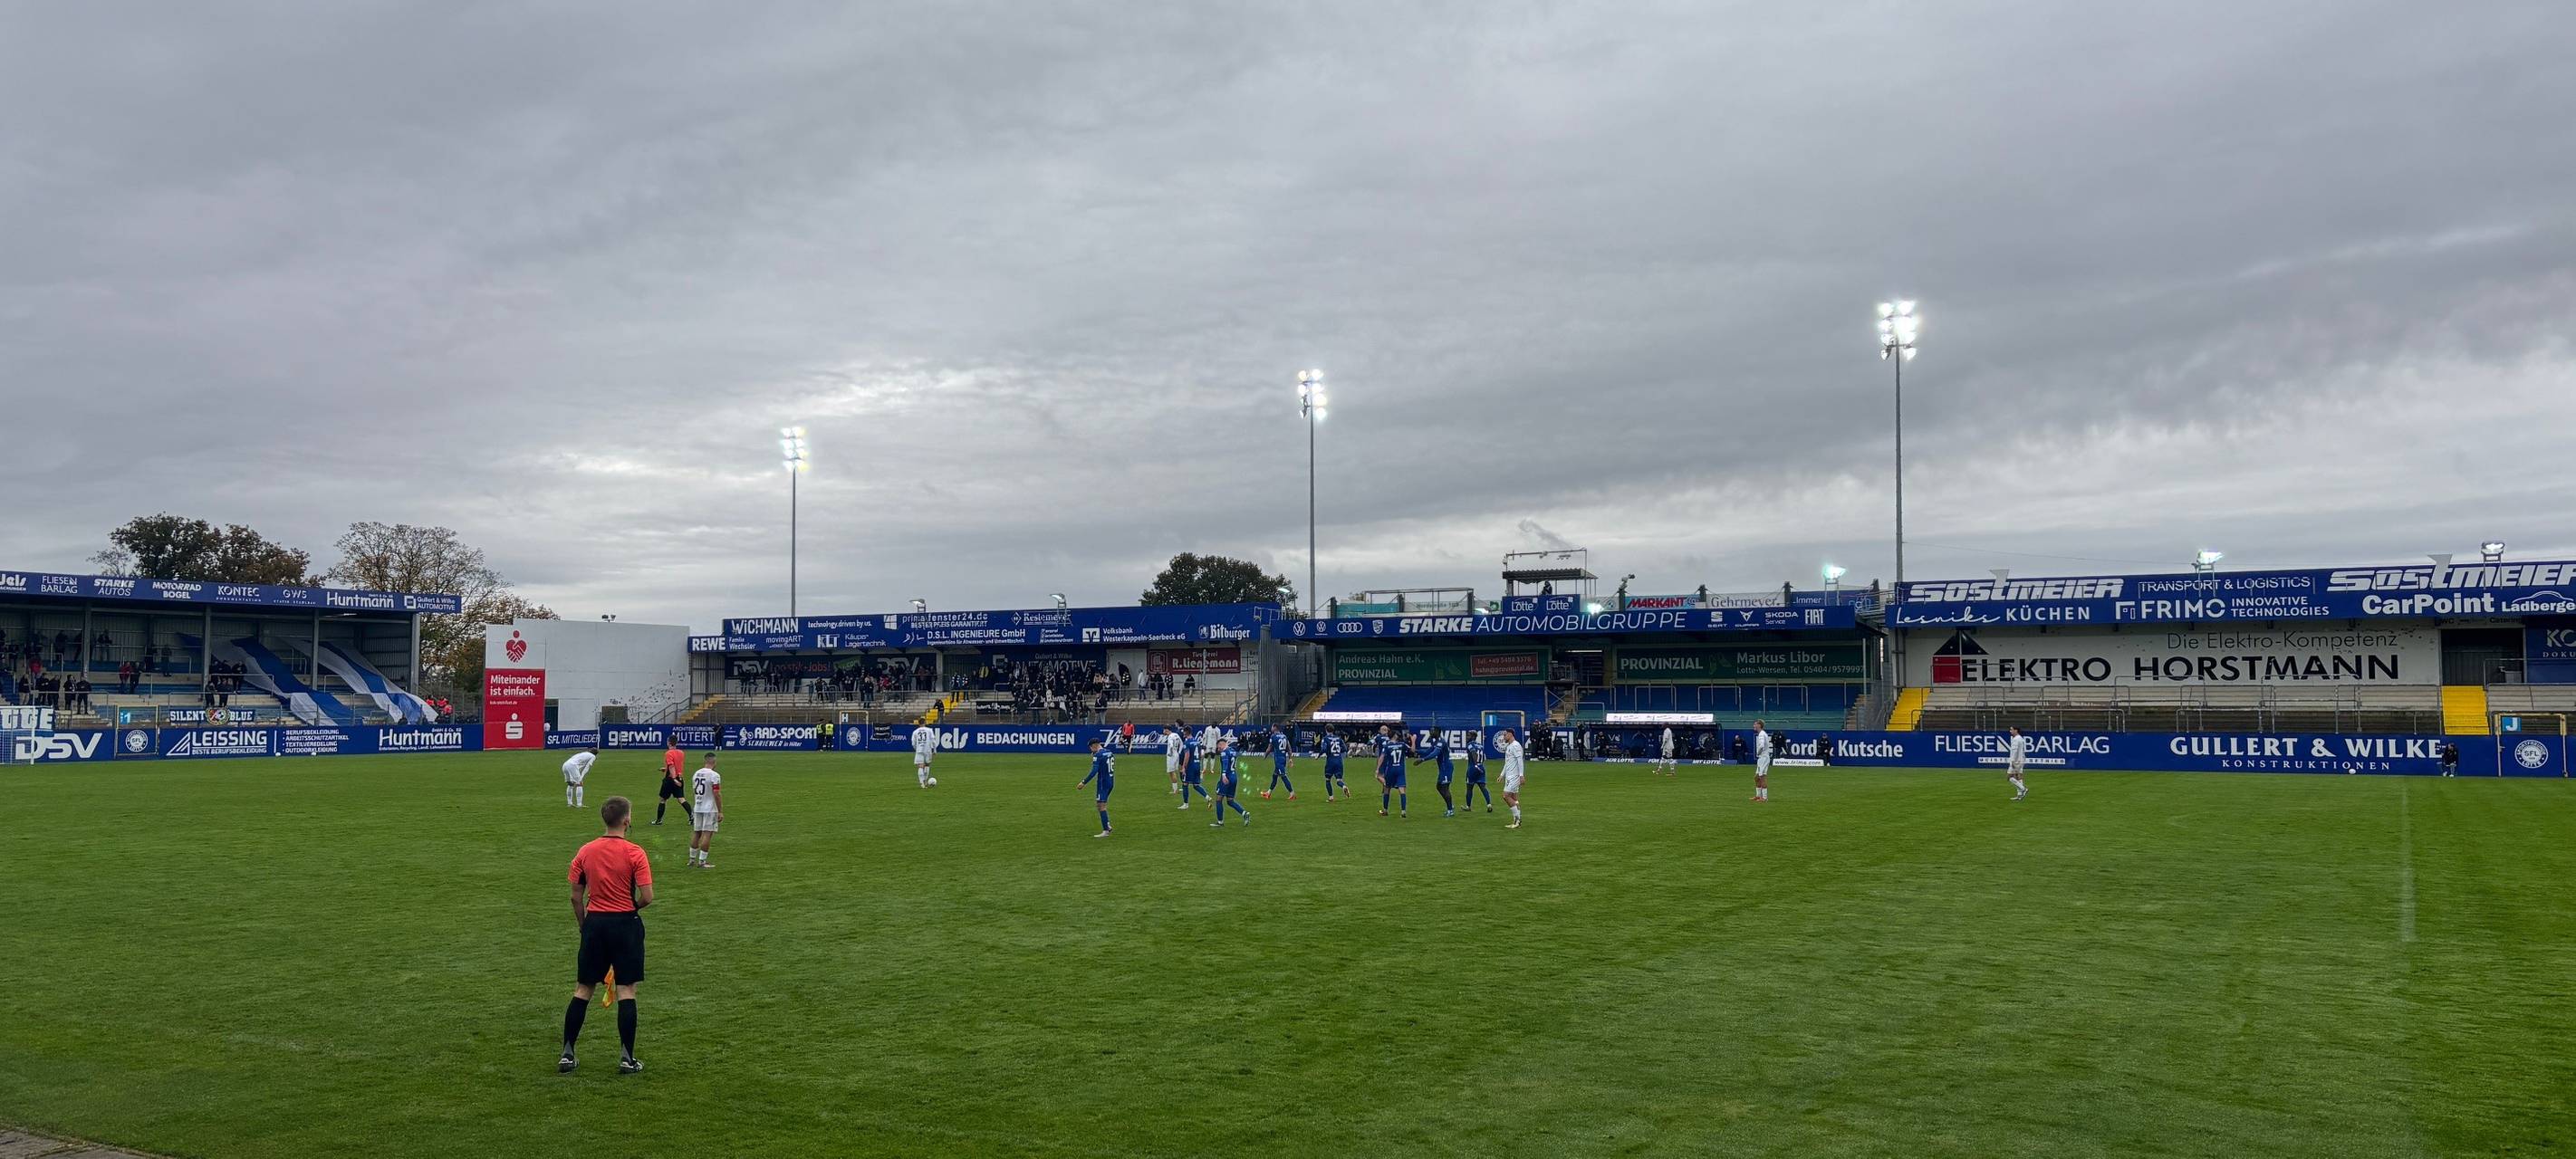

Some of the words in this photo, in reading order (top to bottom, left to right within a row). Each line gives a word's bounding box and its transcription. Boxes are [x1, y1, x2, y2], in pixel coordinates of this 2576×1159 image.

[42, 576, 78, 585] FLIESEN
[93, 578, 135, 588] STARKE
[152, 581, 202, 591] MOTORRAD
[2139, 580, 2221, 592] TRANSPORT
[2224, 580, 2234, 589] &
[2236, 577, 2311, 589] LOGISTICS
[41, 584, 78, 594] BARLAG
[98, 588, 131, 597] AUTOS
[217, 585, 260, 597] KONTEC
[327, 591, 394, 608] Huntmann
[1627, 597, 1685, 608] MARKANT
[1711, 596, 1777, 608] Gehrmeyer
[2231, 596, 2308, 607] INNOVATIVE
[2362, 593, 2494, 614] CarPoint
[418, 603, 456, 611] AUTOMOTIVE
[2006, 605, 2091, 621] KÜCHEN
[2141, 599, 2225, 619] FRIMO
[2231, 606, 2330, 618] TECHNOLOGIES
[1804, 609, 1825, 625] FIAT
[1210, 624, 1251, 640] Bitburger
[1399, 618, 1473, 633] STARKE
[927, 630, 949, 639] D.S.L.
[950, 629, 1000, 638] INGENIEURE
[1002, 628, 1026, 637] GmbH
[2167, 633, 2198, 649] Die
[2207, 631, 2398, 649] Elektro-Kompetenz
[693, 637, 726, 651] REWE
[817, 634, 839, 647] KLT
[1339, 654, 1377, 665] Andreas
[1379, 654, 1404, 665] Hahn
[1620, 656, 1704, 670] PROVINZIAL
[1736, 651, 1786, 664] Markus
[1790, 650, 1826, 664] Libor
[1339, 668, 1398, 679] PROVINZIAL
[1962, 657, 2111, 681] ELEKTRO
[2134, 655, 2398, 680] HORSTMANN
[490, 675, 540, 685] Miteinander
[490, 685, 502, 695] ist
[503, 685, 535, 696] einfach.
[169, 711, 206, 721] SILENT
[229, 711, 254, 721] BLUE
[2505, 717, 2518, 732] J
[192, 731, 267, 746] LEISSING
[379, 728, 462, 746] Huntmann
[609, 727, 662, 746] gerwin
[754, 727, 817, 739] RAD-SPORT
[917, 732, 928, 742] 33
[976, 733, 1075, 744] BEDACHUNGEN
[15, 733, 103, 760] DSV
[547, 736, 561, 744] SFL
[1279, 738, 1287, 751] 20
[1936, 735, 2011, 752] FLIESEN
[2023, 736, 2110, 753] BARLAG
[1331, 741, 1341, 753] 25
[1838, 739, 1903, 757] Kutsche
[2170, 737, 2297, 757] GULLERT
[2312, 738, 2337, 757] &
[2345, 738, 2443, 759] WILKE
[1392, 749, 1403, 763] 17
[2222, 759, 2390, 770] KONSTRUKTIONEN
[694, 778, 706, 796] 25
